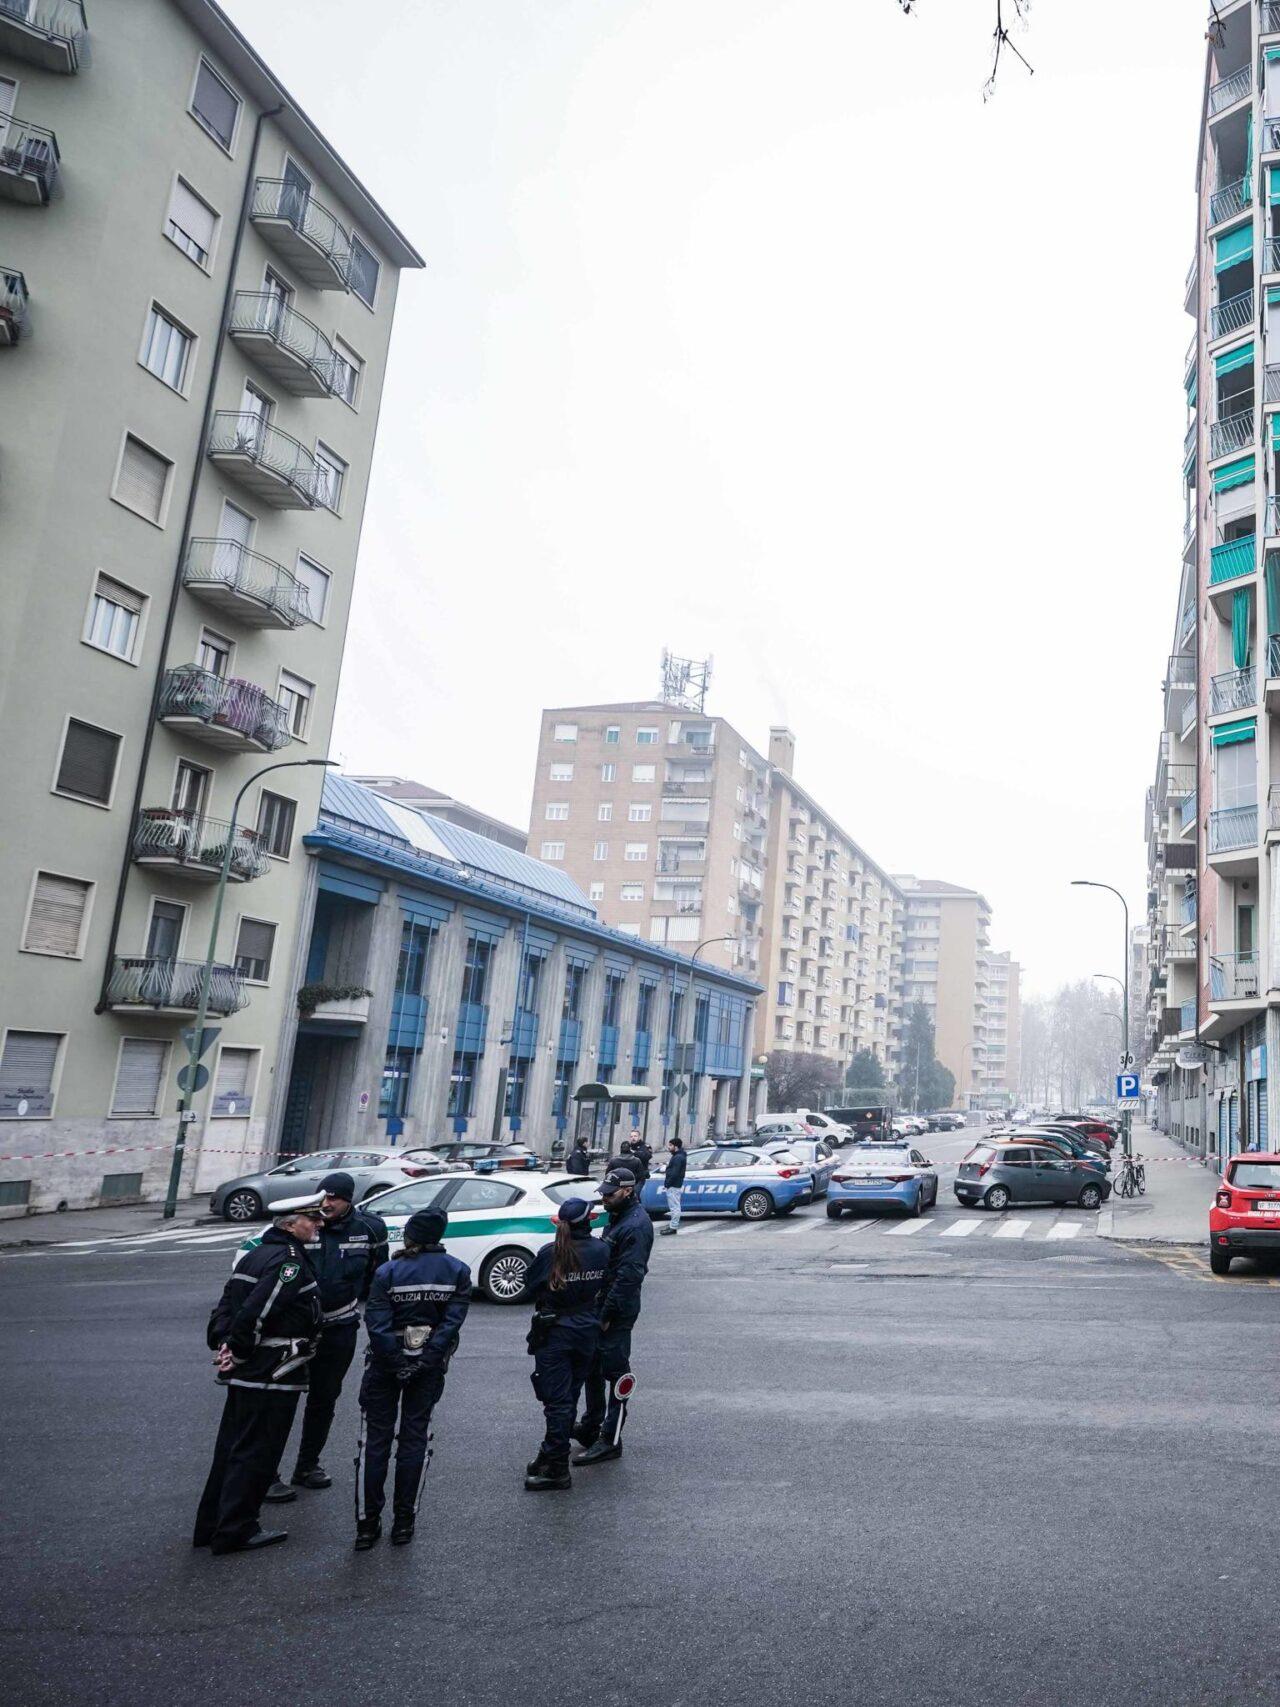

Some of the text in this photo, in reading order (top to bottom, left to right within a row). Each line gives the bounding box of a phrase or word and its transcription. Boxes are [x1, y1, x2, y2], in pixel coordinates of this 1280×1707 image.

[1120, 1055, 1134, 1065] 30
[1121, 1076, 1136, 1096] P
[656, 1183, 738, 1195] PLIZIA
[582, 1269, 605, 1281] LOCALE
